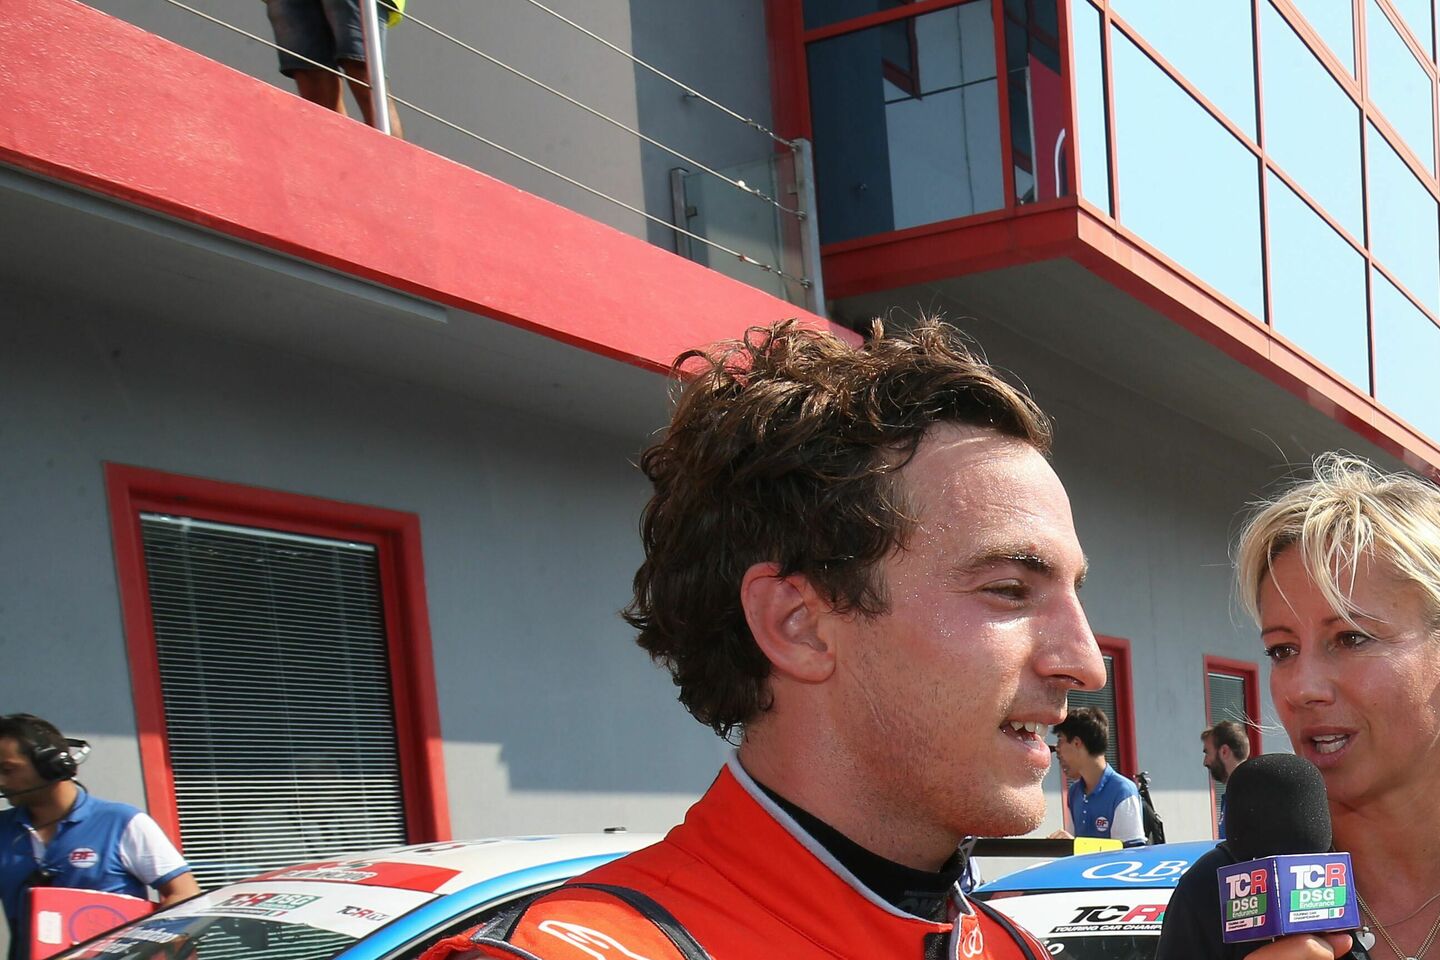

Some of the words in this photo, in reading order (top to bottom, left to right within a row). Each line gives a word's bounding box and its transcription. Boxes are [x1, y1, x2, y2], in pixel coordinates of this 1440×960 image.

[1081, 860, 1188, 882] Q.B
[1290, 863, 1346, 889] TCR
[1226, 869, 1268, 899] TCR
[1232, 896, 1258, 911] DSG
[1300, 888, 1335, 902] DSG
[1299, 899, 1335, 909] Endurance
[1069, 904, 1166, 923] TCR
[1055, 925, 1098, 933] TOURING
[1099, 924, 1122, 932] CAR
[1123, 923, 1162, 932] CHAMP
